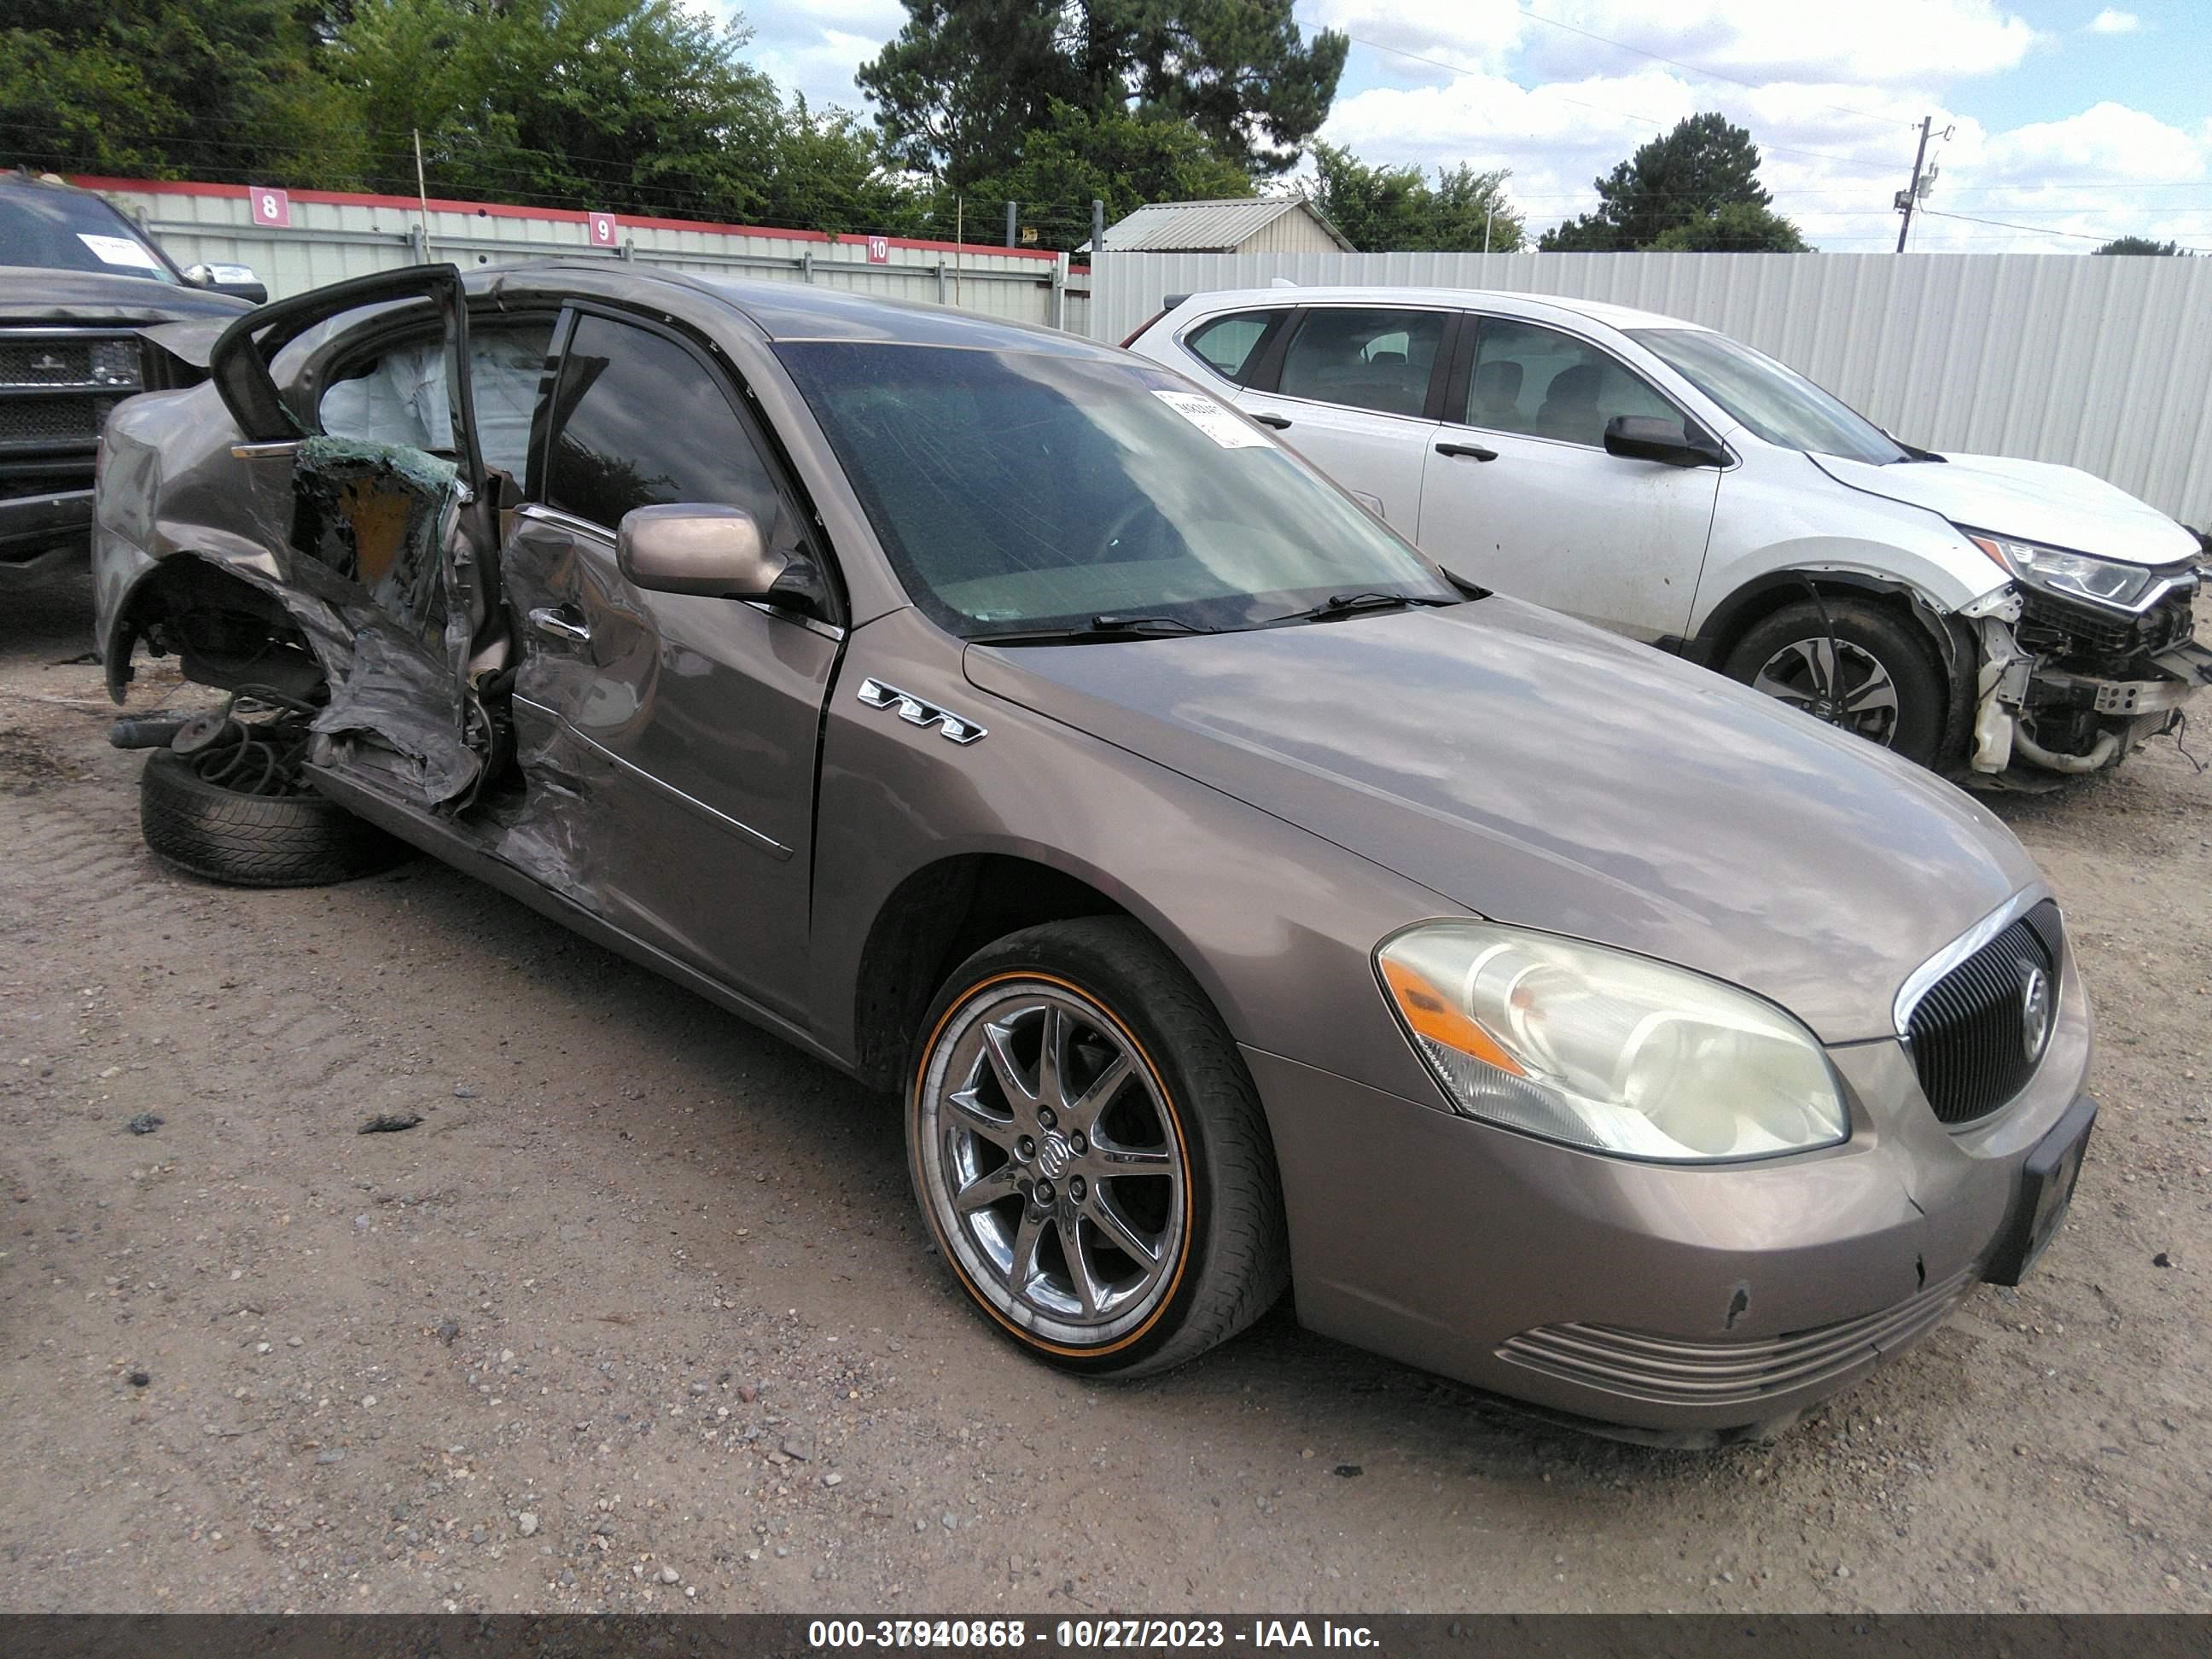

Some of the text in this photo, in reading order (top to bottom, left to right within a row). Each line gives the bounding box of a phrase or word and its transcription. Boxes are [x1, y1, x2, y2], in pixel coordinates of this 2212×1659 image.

[263, 195, 277, 218] 8
[598, 220, 608, 241] 9
[872, 241, 886, 259] 10
